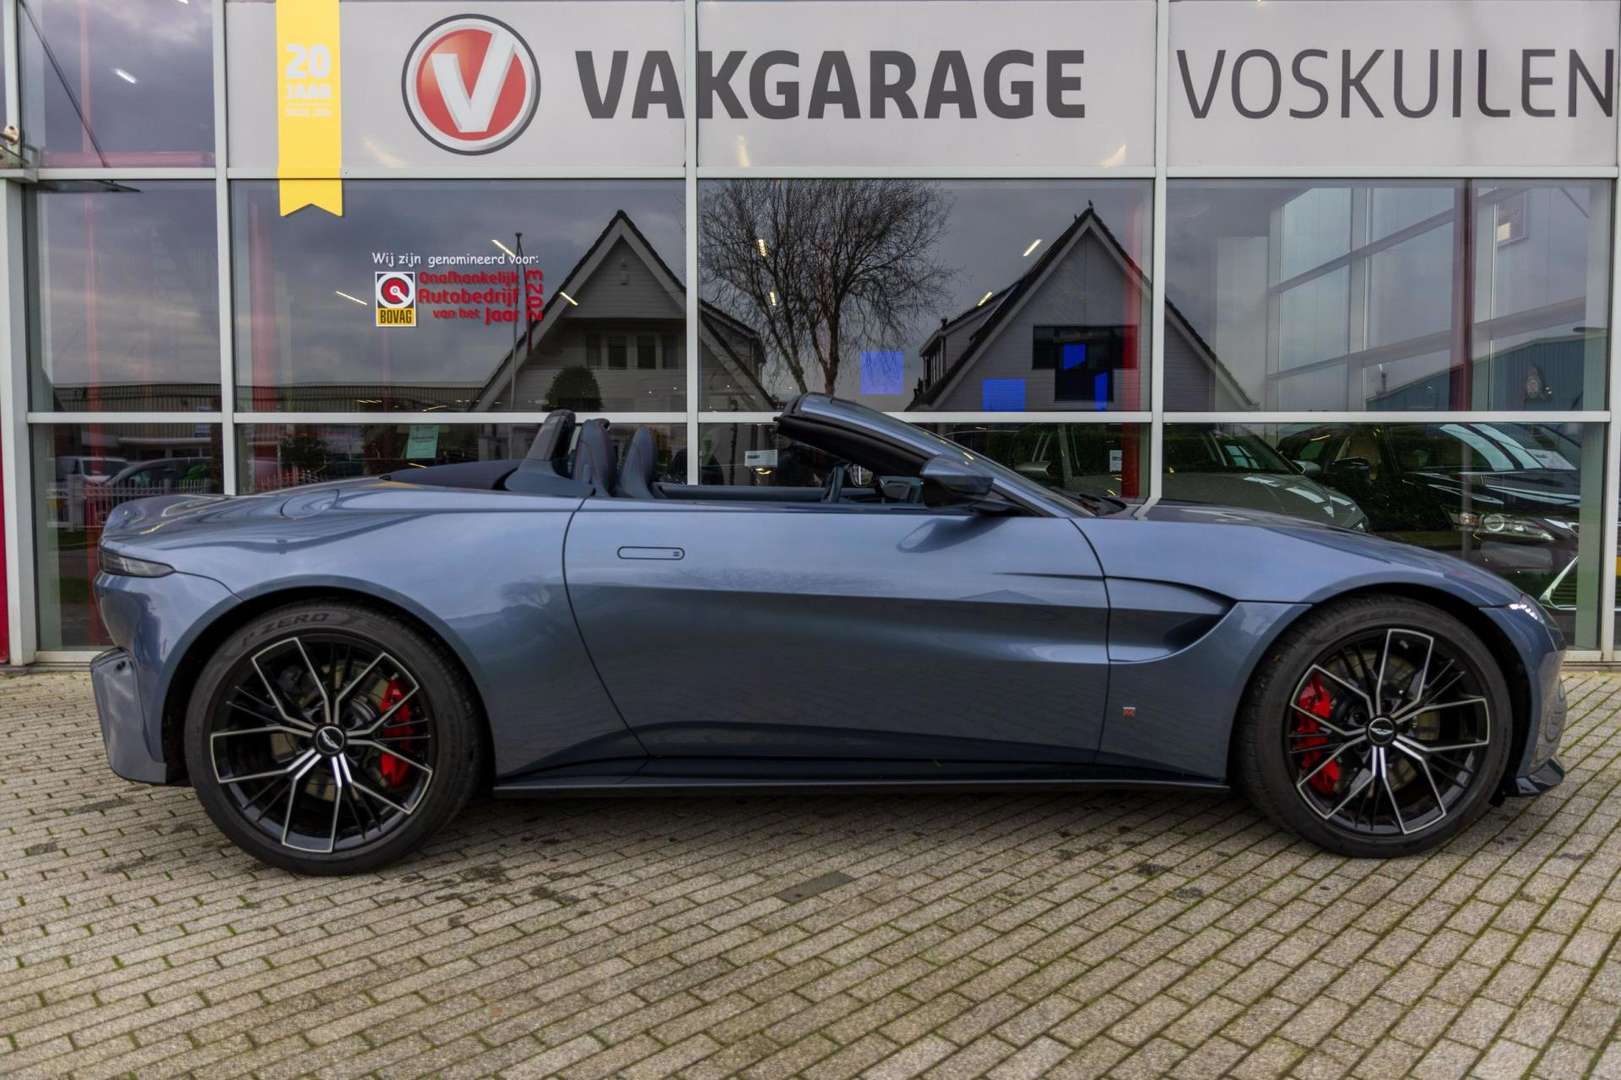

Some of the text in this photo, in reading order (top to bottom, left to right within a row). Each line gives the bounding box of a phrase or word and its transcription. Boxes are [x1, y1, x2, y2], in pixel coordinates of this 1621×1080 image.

[286, 44, 331, 78] 20
[575, 49, 1614, 119] VAKGARAGE VOSKUILEN
[372, 252, 539, 268] Wij zijn genomineerd voor:
[419, 271, 518, 288] Onafhankelijk
[417, 288, 518, 307] Autobedrijf
[526, 268, 544, 321] 2023
[380, 309, 412, 324] BOVAG
[432, 309, 456, 319] van
[458, 307, 480, 319] het
[260, 612, 330, 635] ZERO
